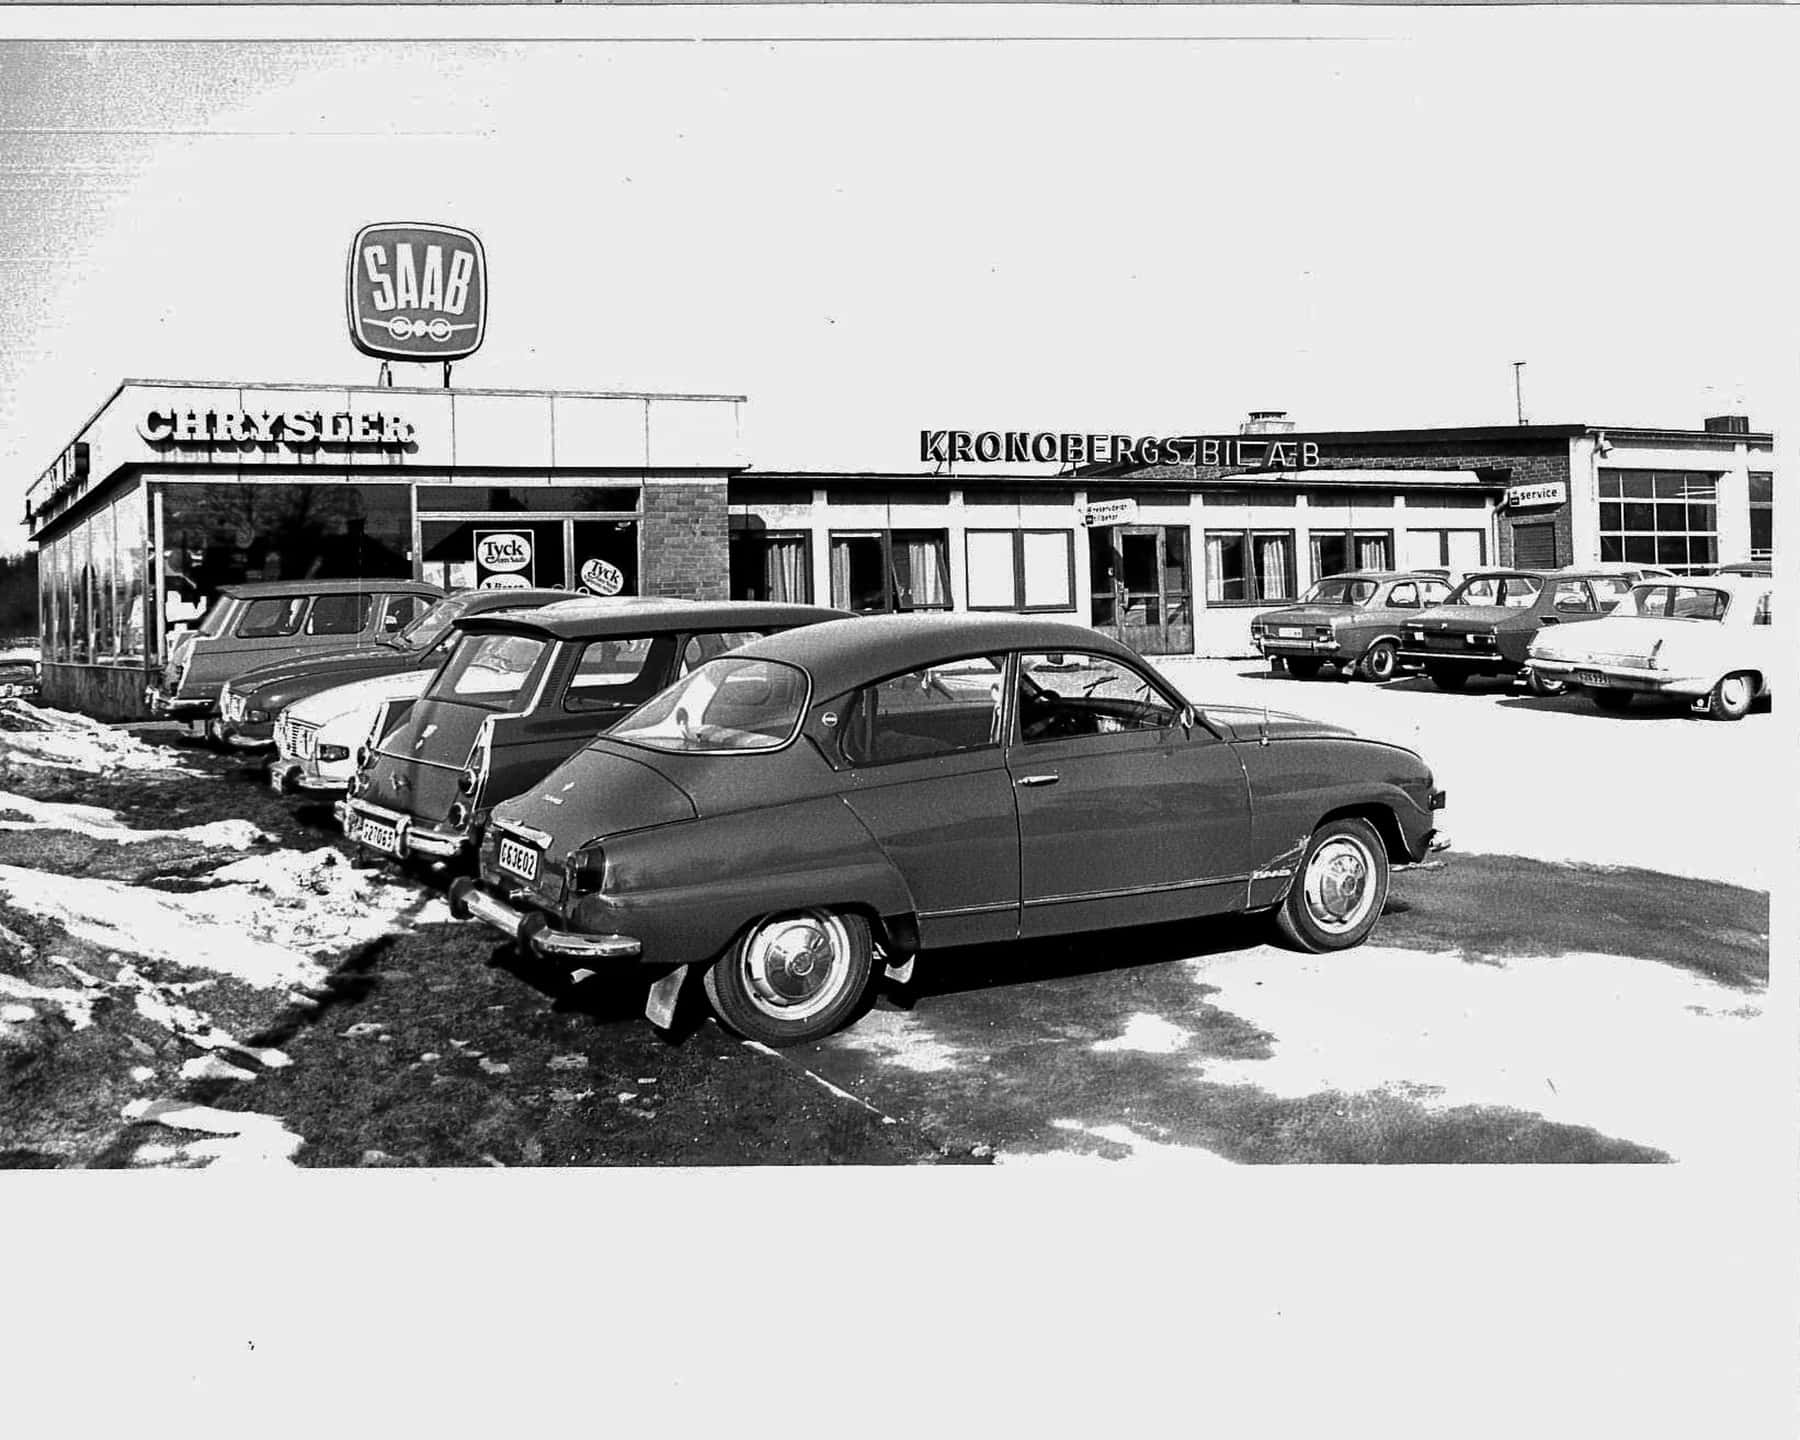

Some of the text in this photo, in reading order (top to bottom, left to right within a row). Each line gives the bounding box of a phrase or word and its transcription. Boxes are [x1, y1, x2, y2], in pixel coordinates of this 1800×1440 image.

[363, 242, 474, 315] SAAB
[136, 408, 418, 452] CHRYSLER
[920, 430, 1183, 465] KRONOBERGS
[1203, 439, 1260, 466] BIL
[1520, 488, 1557, 500] service
[483, 540, 523, 564] Tyck
[587, 559, 620, 584] Tyck
